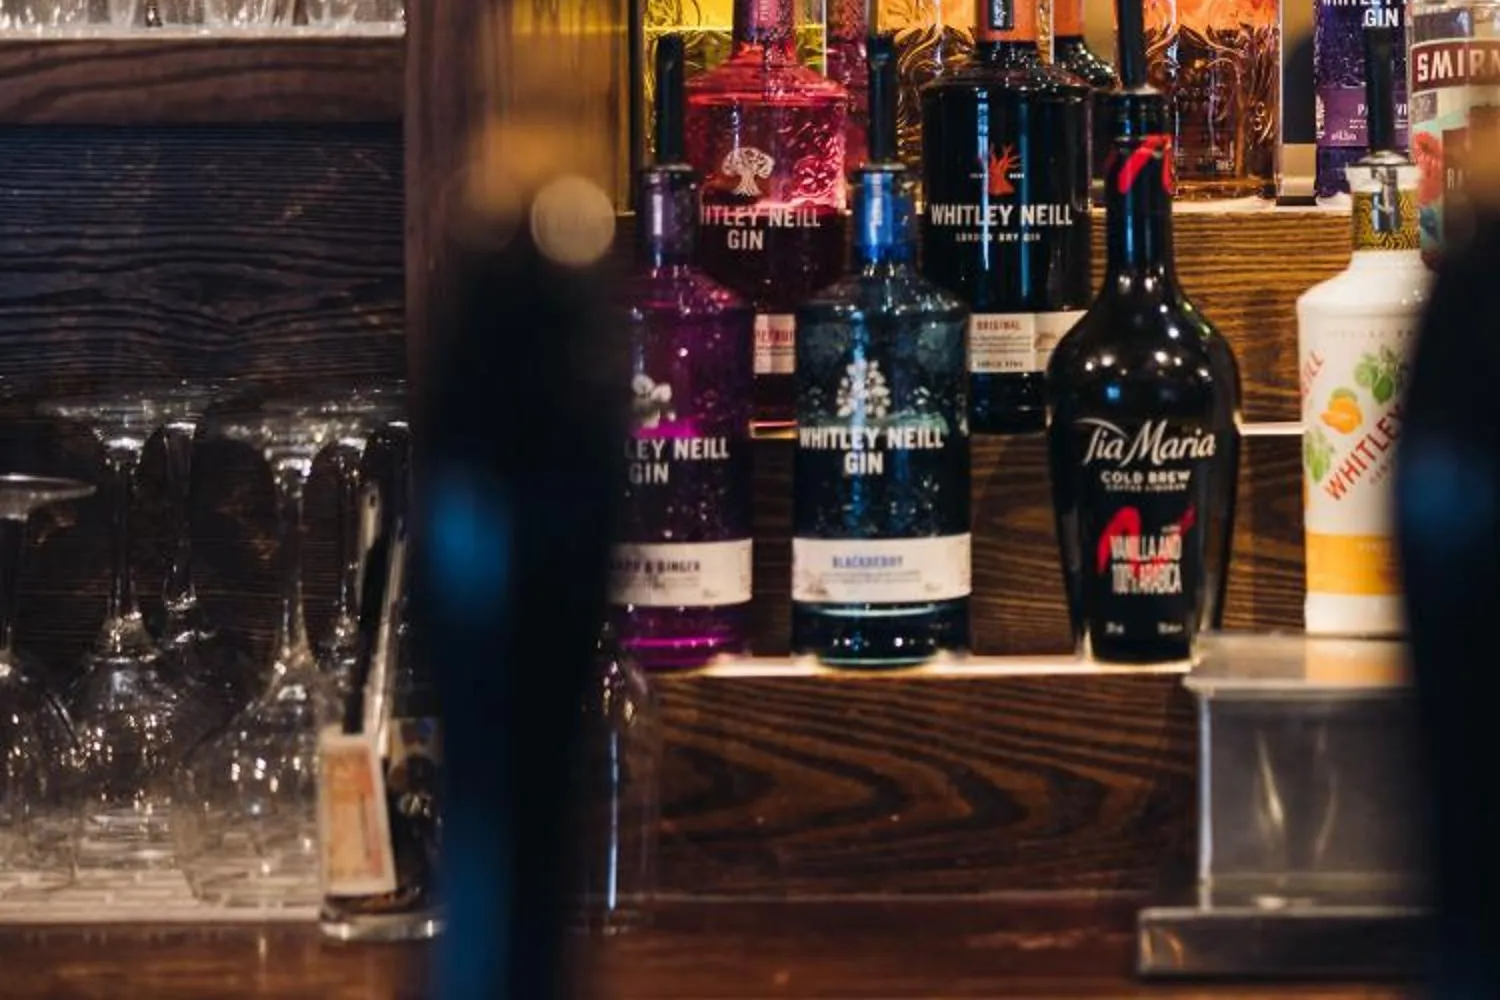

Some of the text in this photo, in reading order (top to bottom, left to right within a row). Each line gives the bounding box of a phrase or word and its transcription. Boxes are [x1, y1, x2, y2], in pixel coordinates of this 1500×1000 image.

[1364, 8, 1399, 28] GIN
[701, 205, 821, 228] ITLEY NEILL
[931, 203, 1073, 227] WHITLEY NEILL
[727, 229, 764, 251] GIN
[673, 436, 731, 460] NEILL
[800, 426, 945, 449] WHITLEY NEILL
[1072, 417, 1217, 467] Tia Maria
[629, 461, 670, 485] GIN
[844, 450, 884, 475] GIN
[1100, 470, 1192, 484] COLD BREW
